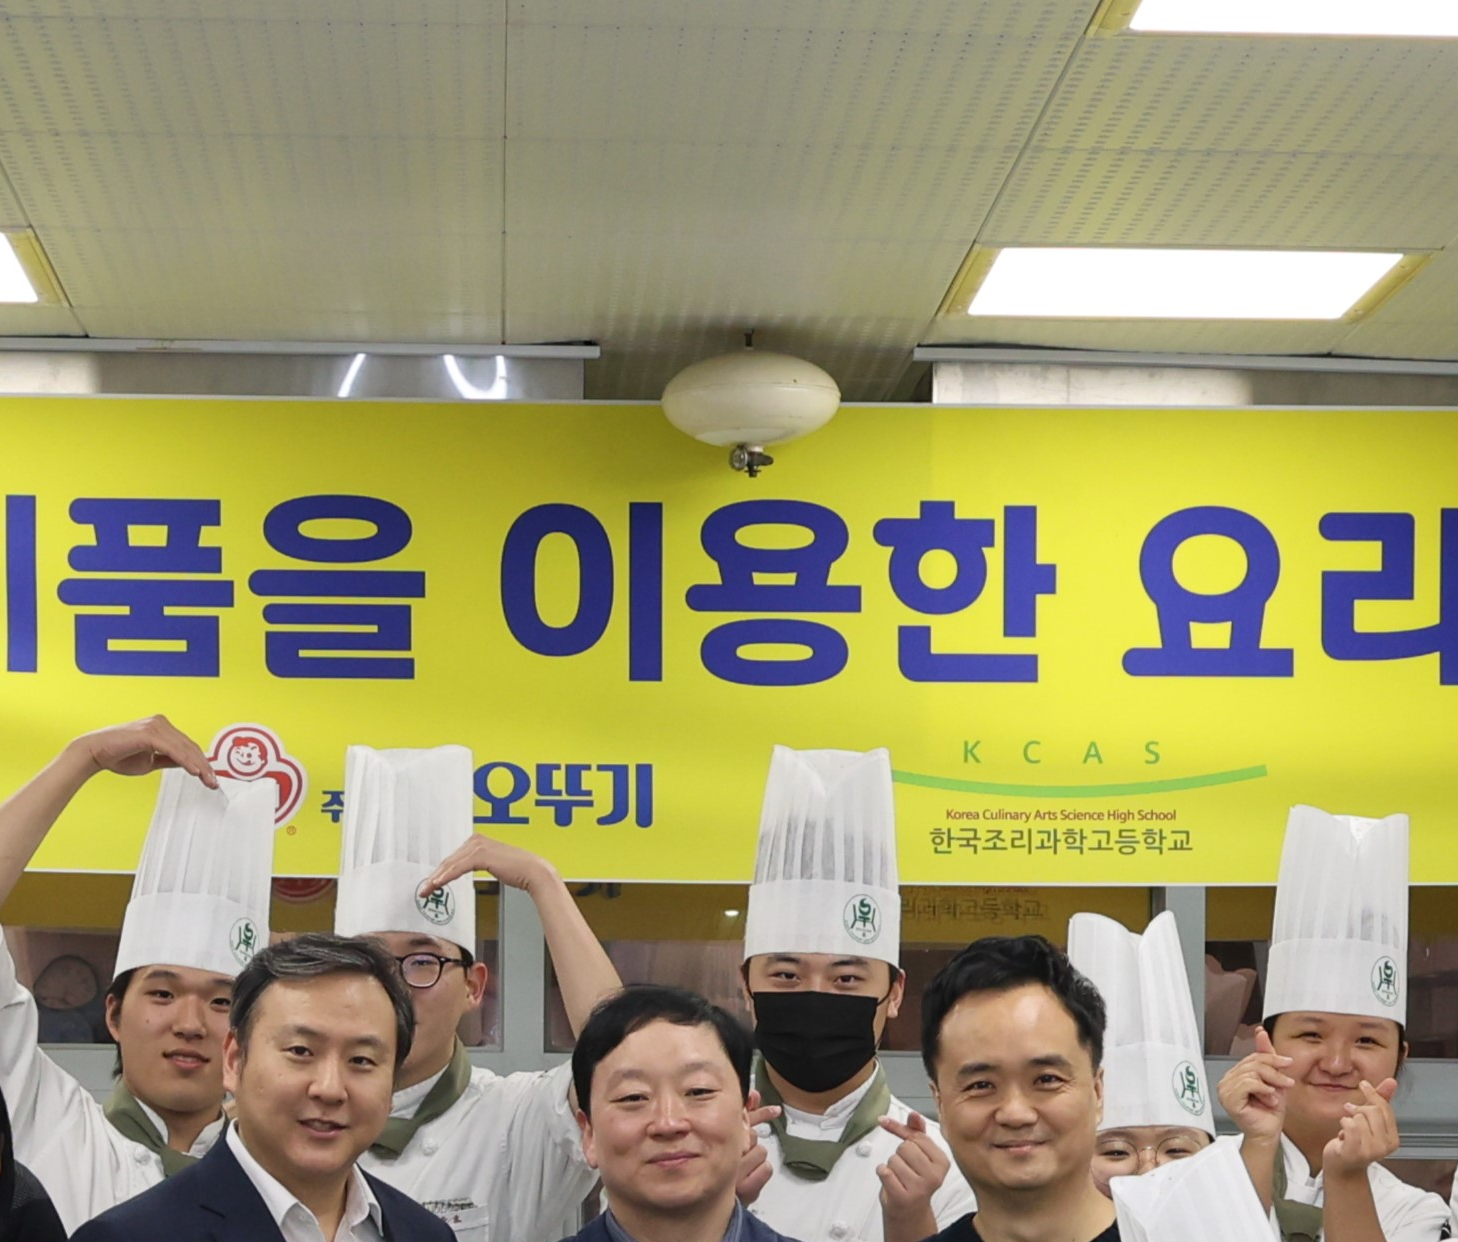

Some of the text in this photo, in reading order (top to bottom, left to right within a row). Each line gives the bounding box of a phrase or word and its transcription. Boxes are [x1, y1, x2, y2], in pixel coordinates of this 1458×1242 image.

[500, 499, 1058, 688] 이용한
[473, 761, 653, 828] 오뚜기
[945, 809, 1177, 823] Korea Culinary Arts Science High School
[929, 827, 1193, 855] 한국조리과학고등학교
